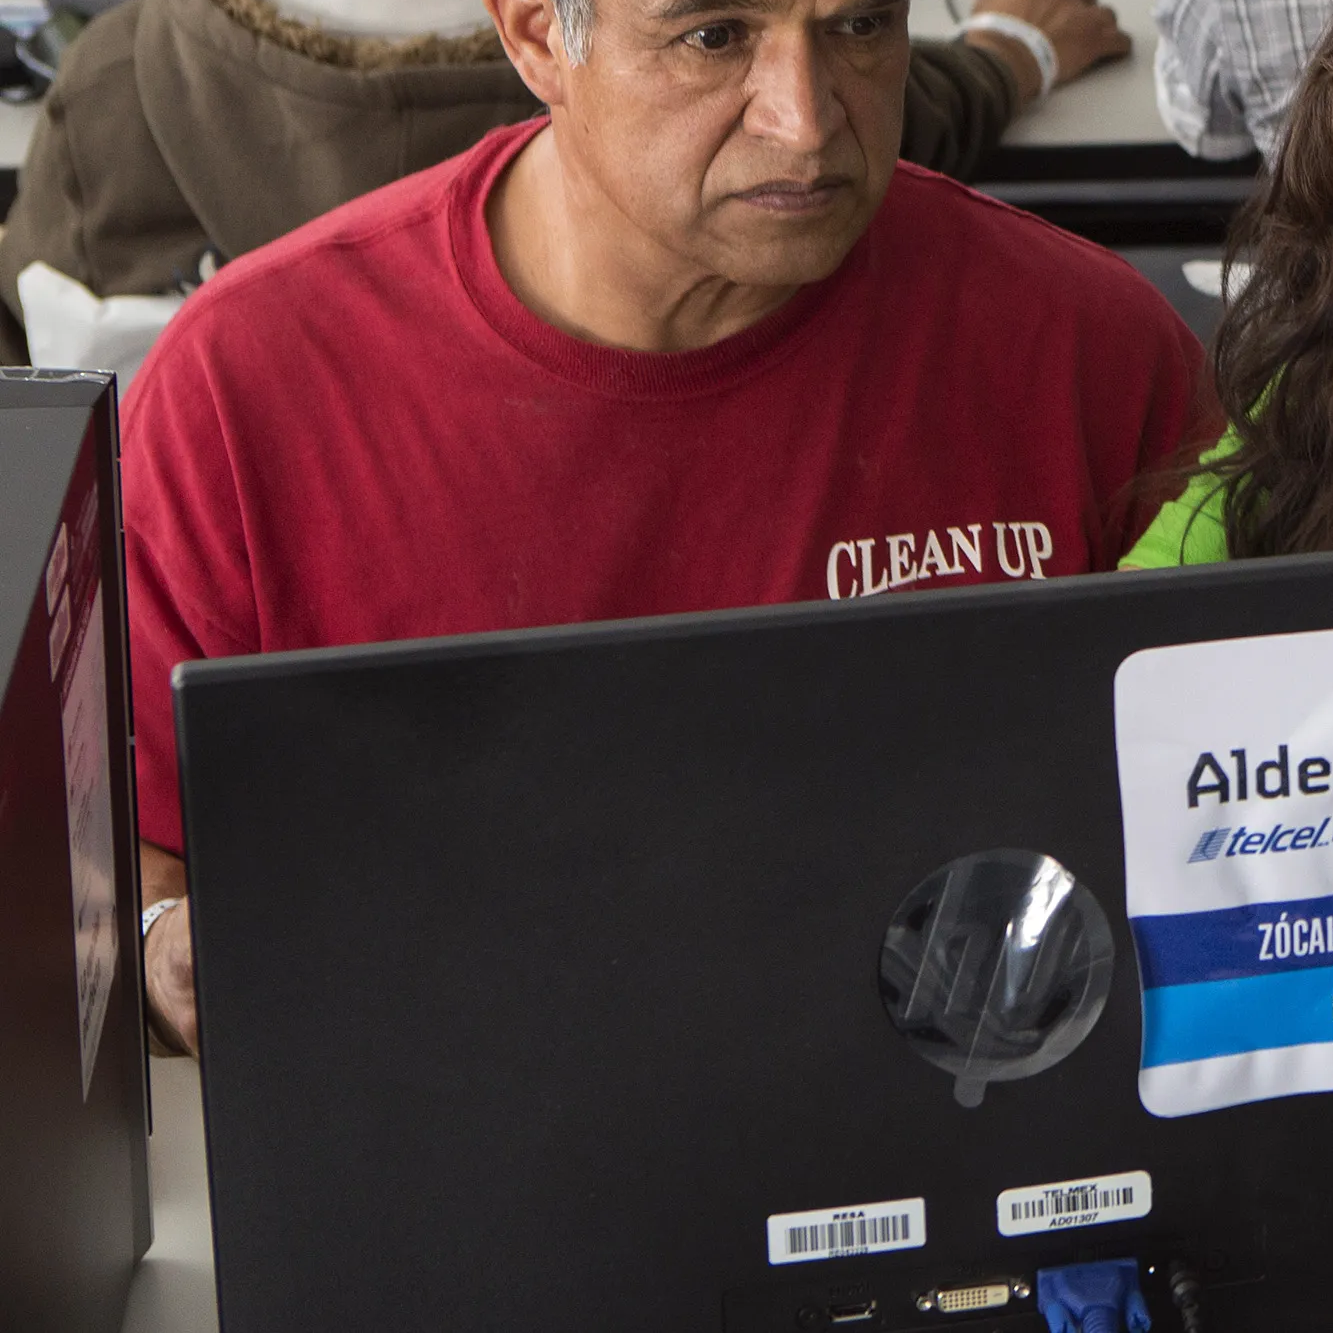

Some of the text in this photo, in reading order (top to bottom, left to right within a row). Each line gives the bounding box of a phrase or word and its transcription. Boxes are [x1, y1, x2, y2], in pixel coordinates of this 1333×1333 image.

[827, 521, 1053, 600] CLEAN UP
[1226, 817, 1331, 857] telcel
[1043, 1183, 1098, 1198] TELMEX
[1049, 1213, 1098, 1227] AD01307
